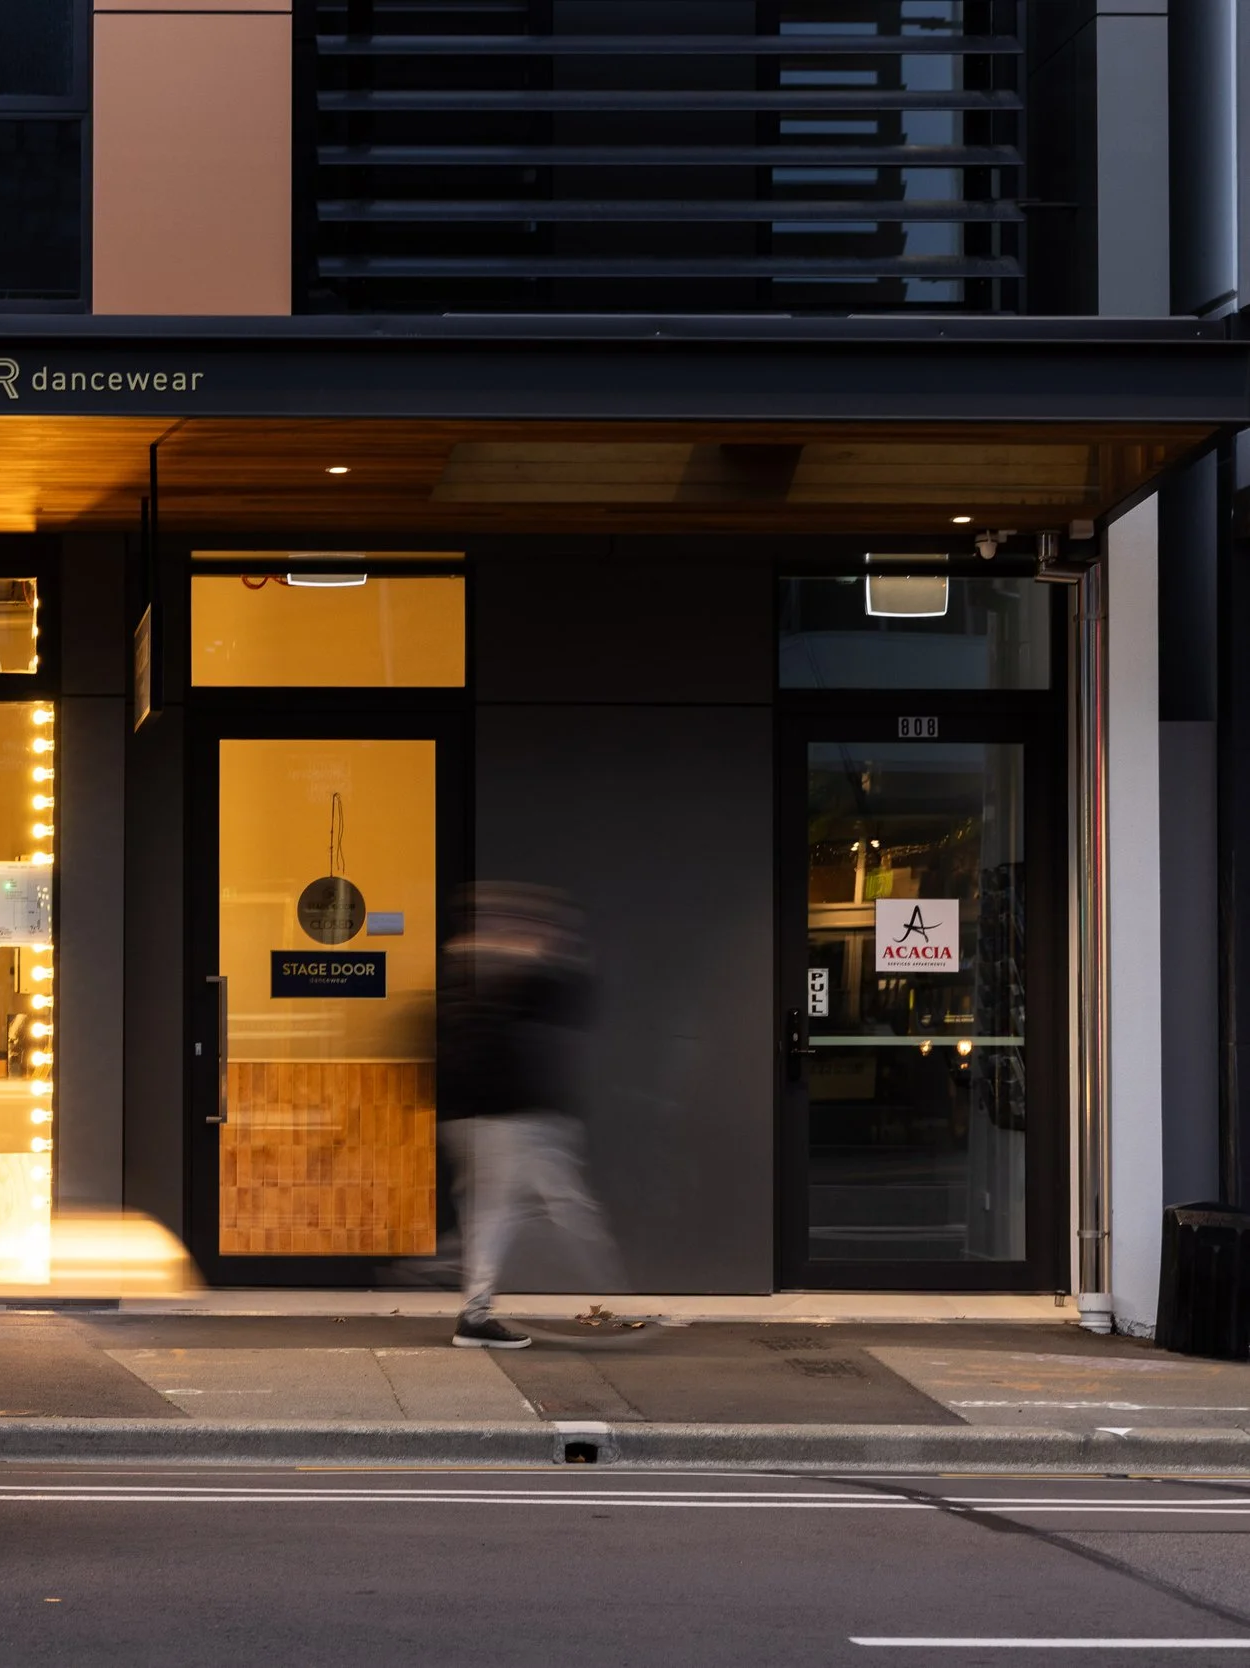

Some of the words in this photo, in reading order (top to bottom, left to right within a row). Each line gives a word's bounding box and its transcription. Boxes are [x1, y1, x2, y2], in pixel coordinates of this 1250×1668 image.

[31, 366, 205, 391] dancewear
[901, 718, 936, 736] 808
[882, 945, 952, 959] ACACIA
[282, 963, 327, 976] STAGE
[331, 963, 375, 976] DOOR
[810, 972, 825, 1014] PULL
